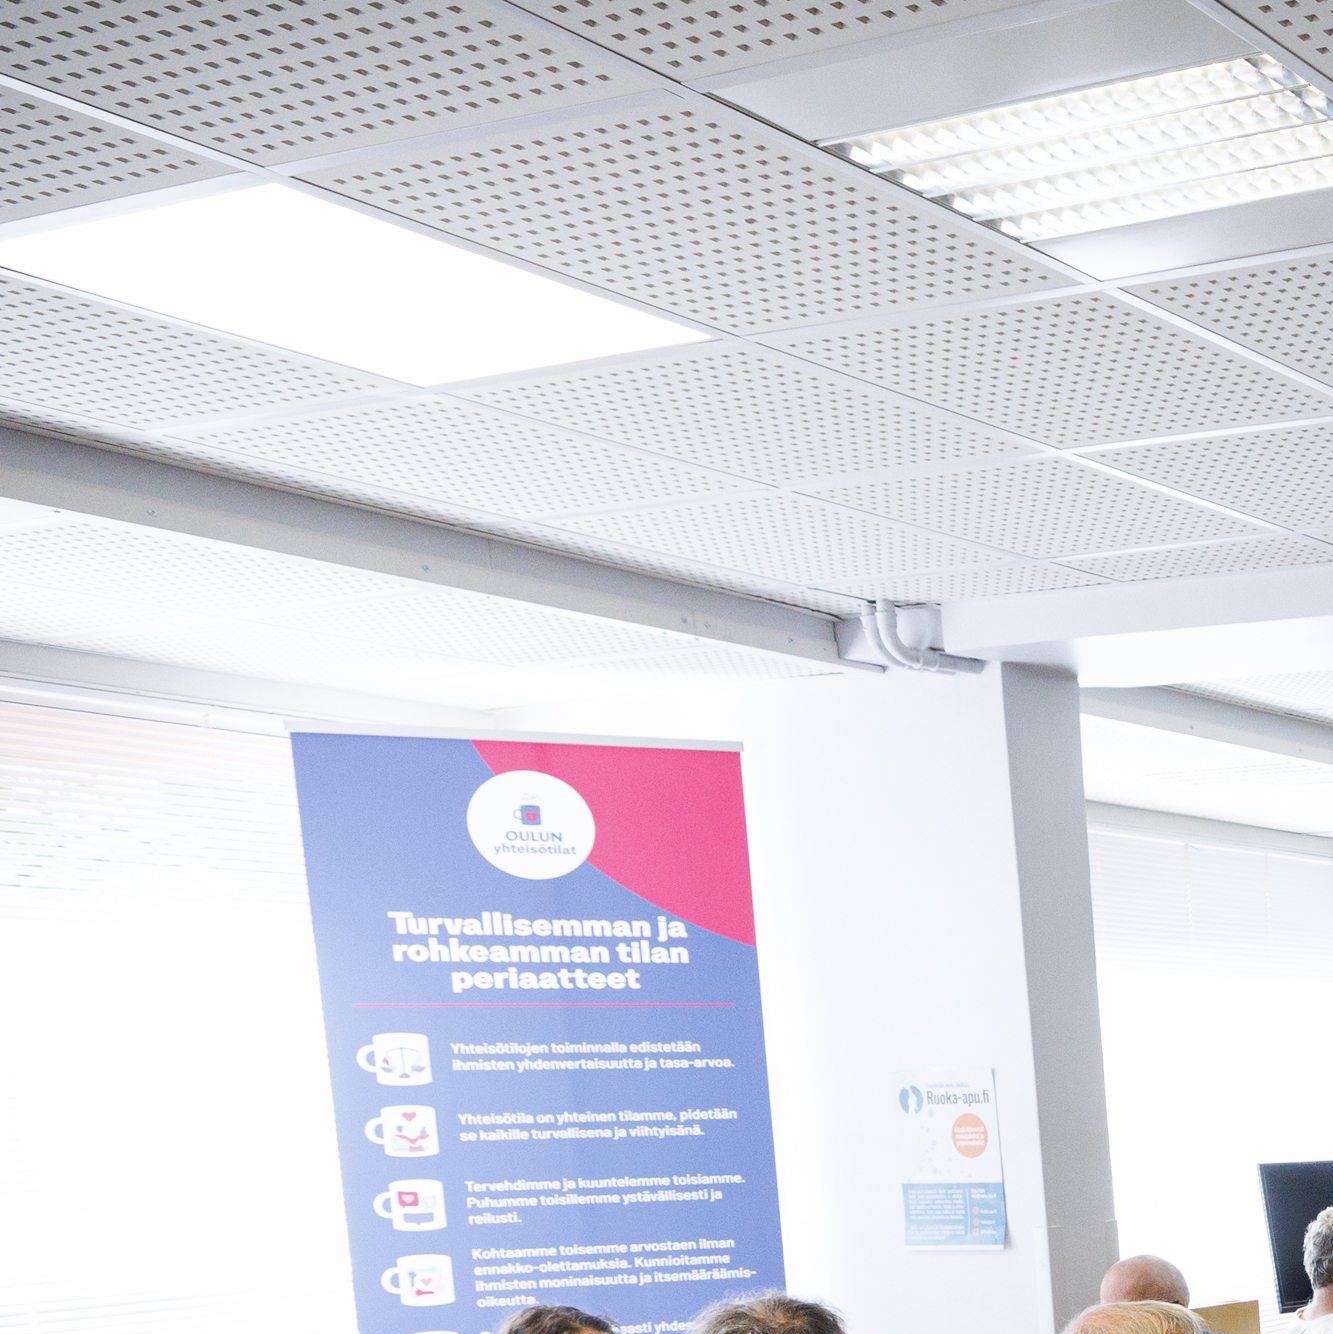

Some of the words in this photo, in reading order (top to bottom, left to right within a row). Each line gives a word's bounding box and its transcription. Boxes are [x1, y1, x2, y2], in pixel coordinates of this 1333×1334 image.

[505, 830, 563, 842] OULUN
[493, 843, 577, 855] yhteisötilat
[387, 911, 652, 937] Turvallisemman
[657, 915, 689, 942] ja
[392, 937, 610, 963] rohkeamman
[616, 939, 690, 964] tilan
[451, 966, 641, 993] periaatteet
[450, 1042, 549, 1057] Yhteisötilojen
[550, 1041, 628, 1054] toiminnalla
[629, 1040, 701, 1053] edistetään
[451, 1058, 515, 1071] ihmisten
[516, 1058, 642, 1073] yhdenvertaisuutta
[643, 1058, 657, 1071] ja
[659, 1057, 736, 1069] tasa-arvoa.
[926, 1089, 990, 1107] Ruoka-apu.fi
[457, 1112, 534, 1126] Yhteisötila
[536, 1114, 555, 1125] on
[556, 1111, 616, 1126] yhteinen
[618, 1109, 677, 1123] tilamme,
[679, 1107, 737, 1123] pidetään
[459, 1130, 478, 1141] se
[479, 1128, 529, 1141] kaikille
[531, 1126, 612, 1140] turvallisena
[613, 1126, 627, 1140] ja
[629, 1123, 705, 1139] viihtyisänä.
[465, 1179, 561, 1193] Tervehdimme
[561, 1178, 577, 1192] ja
[578, 1176, 671, 1189] kuuntelemme
[672, 1173, 746, 1186] toisiamme.
[467, 1196, 538, 1209] Puhumme
[540, 1193, 621, 1207] toisillemme
[622, 1189, 709, 1205] ystävällisesti
[709, 1189, 723, 1202] ja
[468, 1211, 522, 1225] reilusti.
[472, 1246, 558, 1261] Kohtaamme
[559, 1243, 628, 1257] toisemme
[629, 1240, 697, 1253] arvostaen
[698, 1238, 735, 1250] ilman
[474, 1259, 632, 1276] ennakko-olettamuksia.
[634, 1254, 730, 1268] Kunnioitamme
[475, 1278, 537, 1292] ihmisten
[539, 1274, 638, 1290] moninaisuutta
[638, 1273, 652, 1286] ja
[653, 1267, 757, 1282] itsemääräämis-
[477, 1295, 539, 1308] oikeutta.
